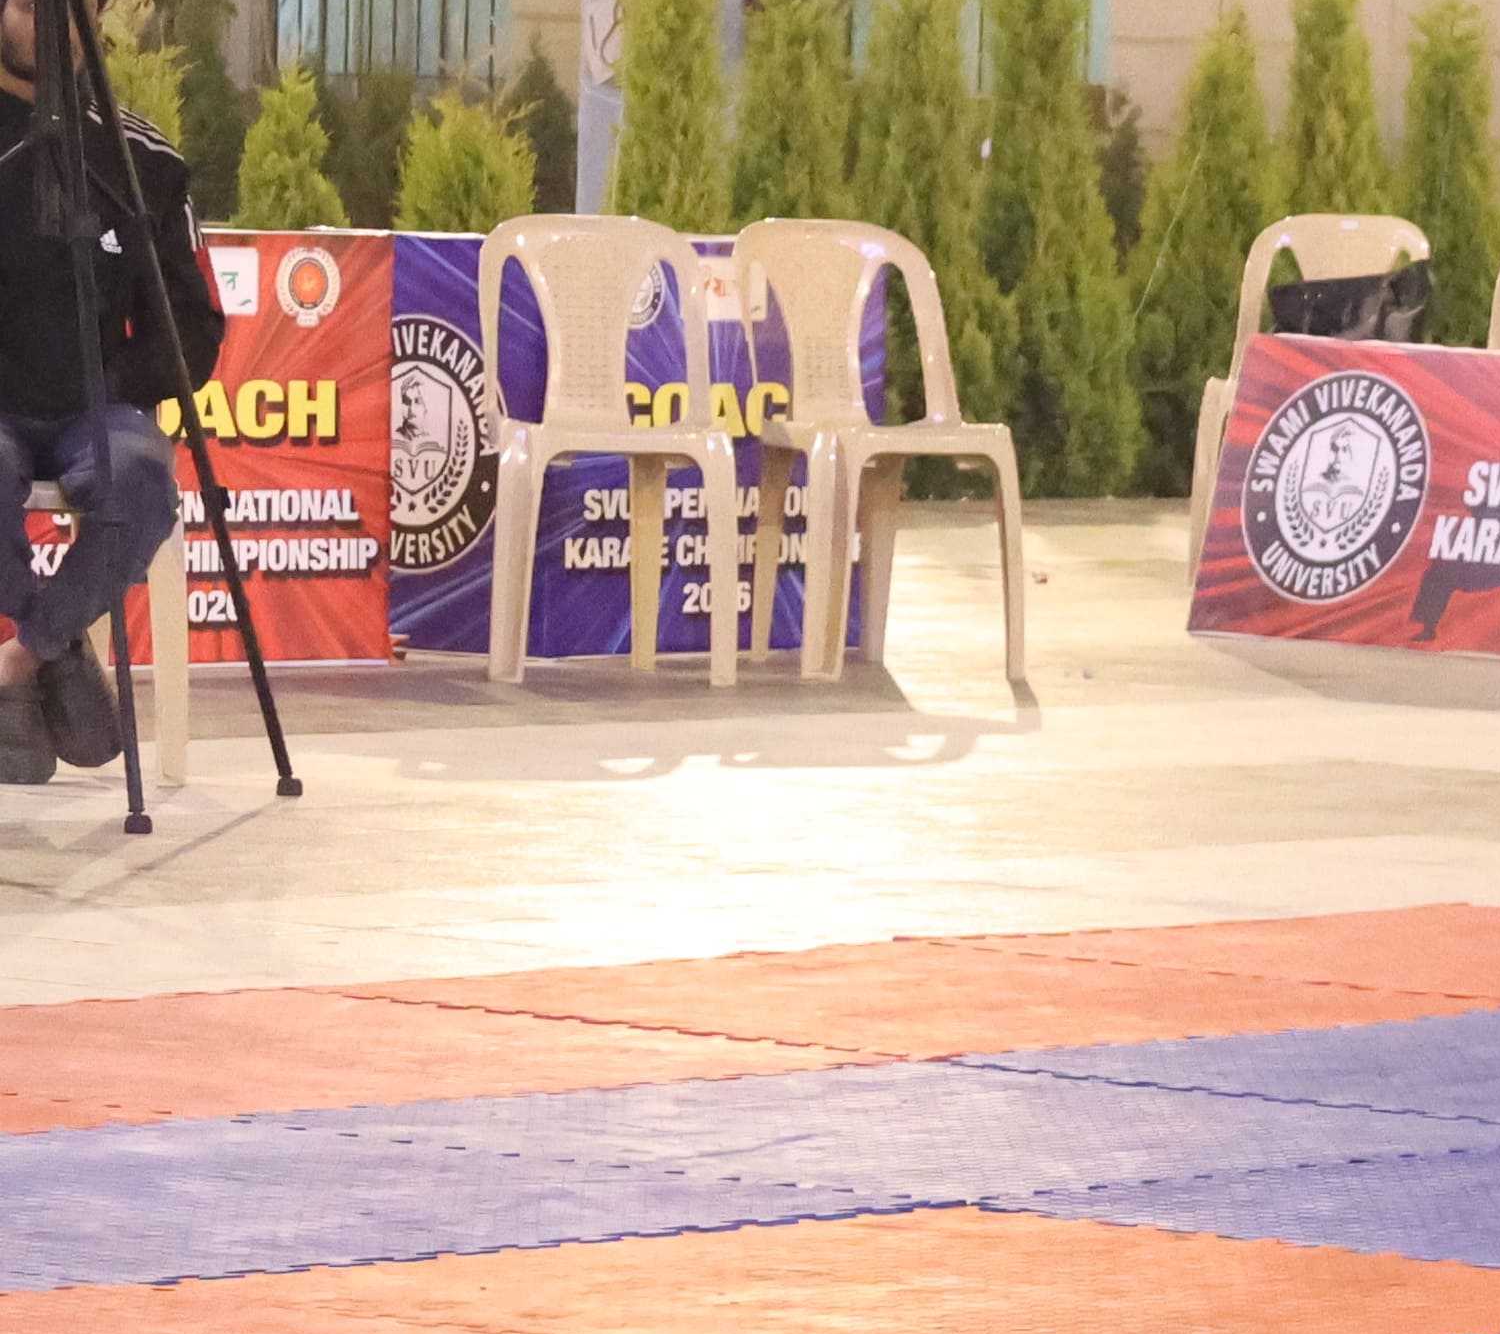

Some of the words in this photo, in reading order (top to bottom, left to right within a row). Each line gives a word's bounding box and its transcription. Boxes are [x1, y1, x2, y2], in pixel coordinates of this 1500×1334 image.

[625, 381, 789, 437] COAC
[1252, 400, 1311, 493] SWAMI
[1314, 379, 1425, 502] VIVEKANANDA
[1261, 540, 1382, 597] UNIVERSITY
[682, 581, 751, 614] 206
